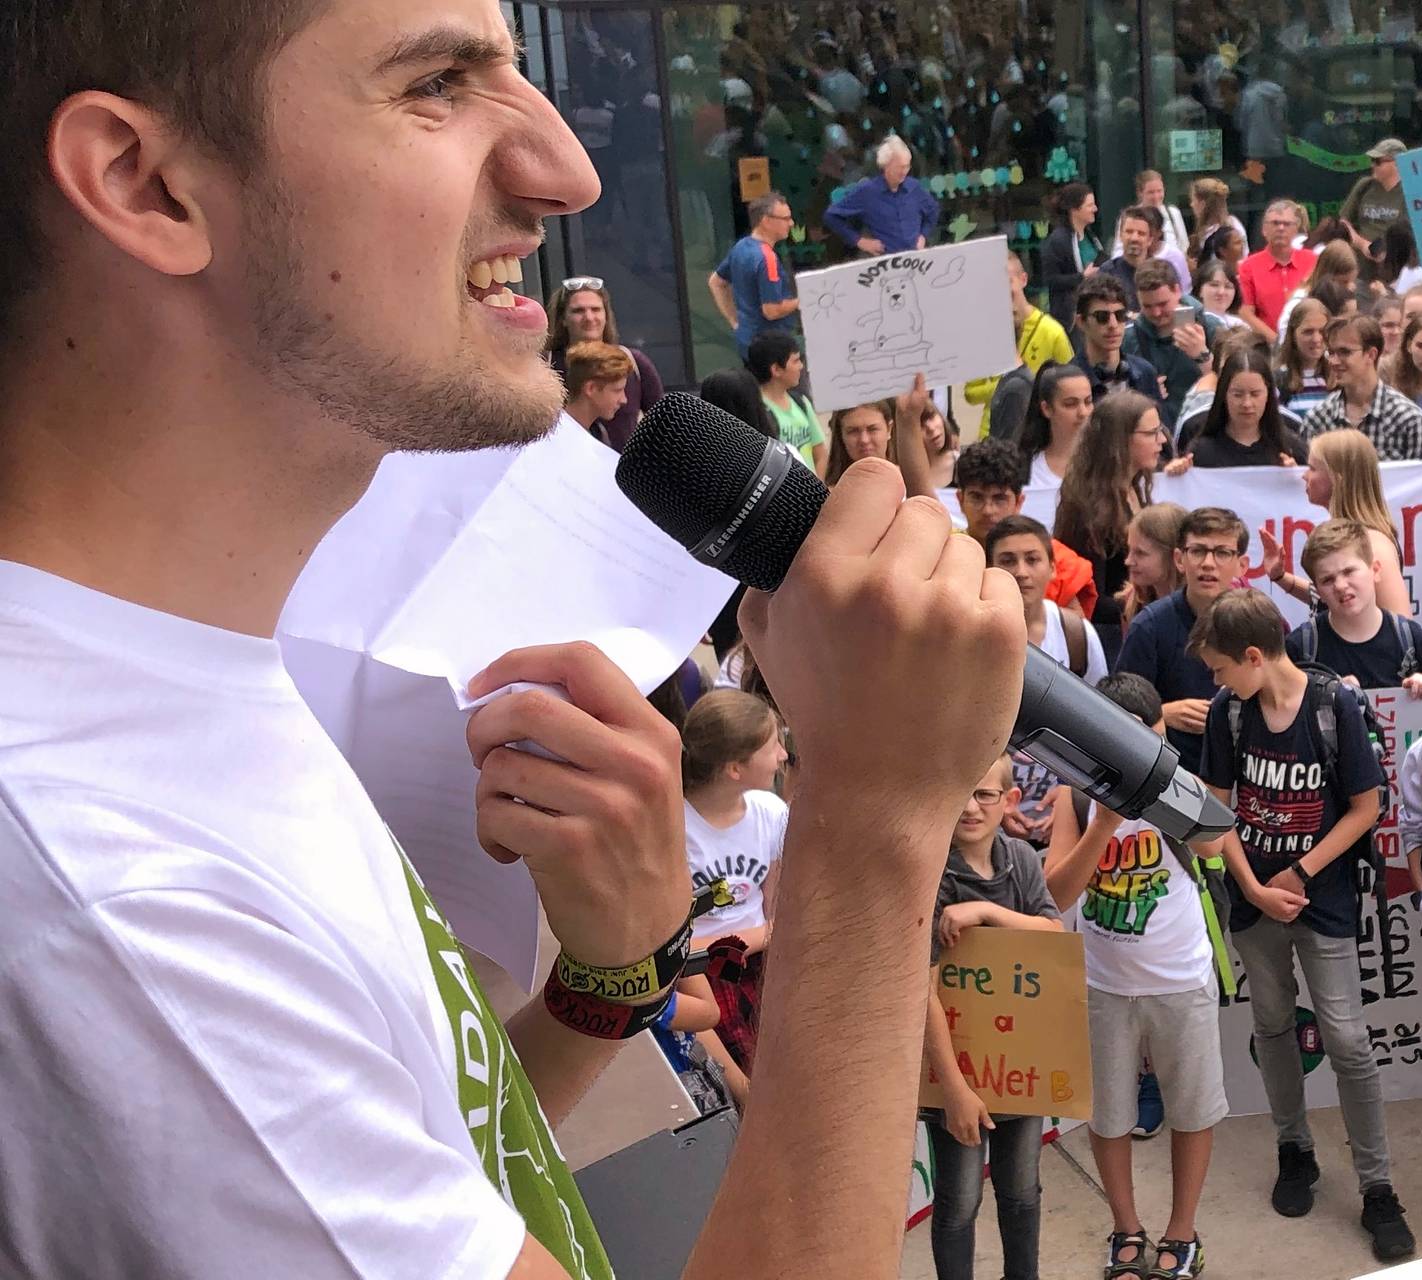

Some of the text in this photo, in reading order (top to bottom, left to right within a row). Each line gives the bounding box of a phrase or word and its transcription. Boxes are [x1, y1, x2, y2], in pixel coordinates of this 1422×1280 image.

[1412, 160, 1419, 175] I
[858, 259, 889, 288] NOT
[717, 474, 772, 547] SENNHEISER
[1097, 829, 1163, 874] OOD
[1236, 823, 1314, 853] OTHING
[692, 854, 768, 890] OLLISTE
[592, 972, 650, 998] ROCK
[941, 963, 1041, 998] ere is
[994, 1015, 1014, 1033] a
[1051, 1070, 1074, 1104] B
